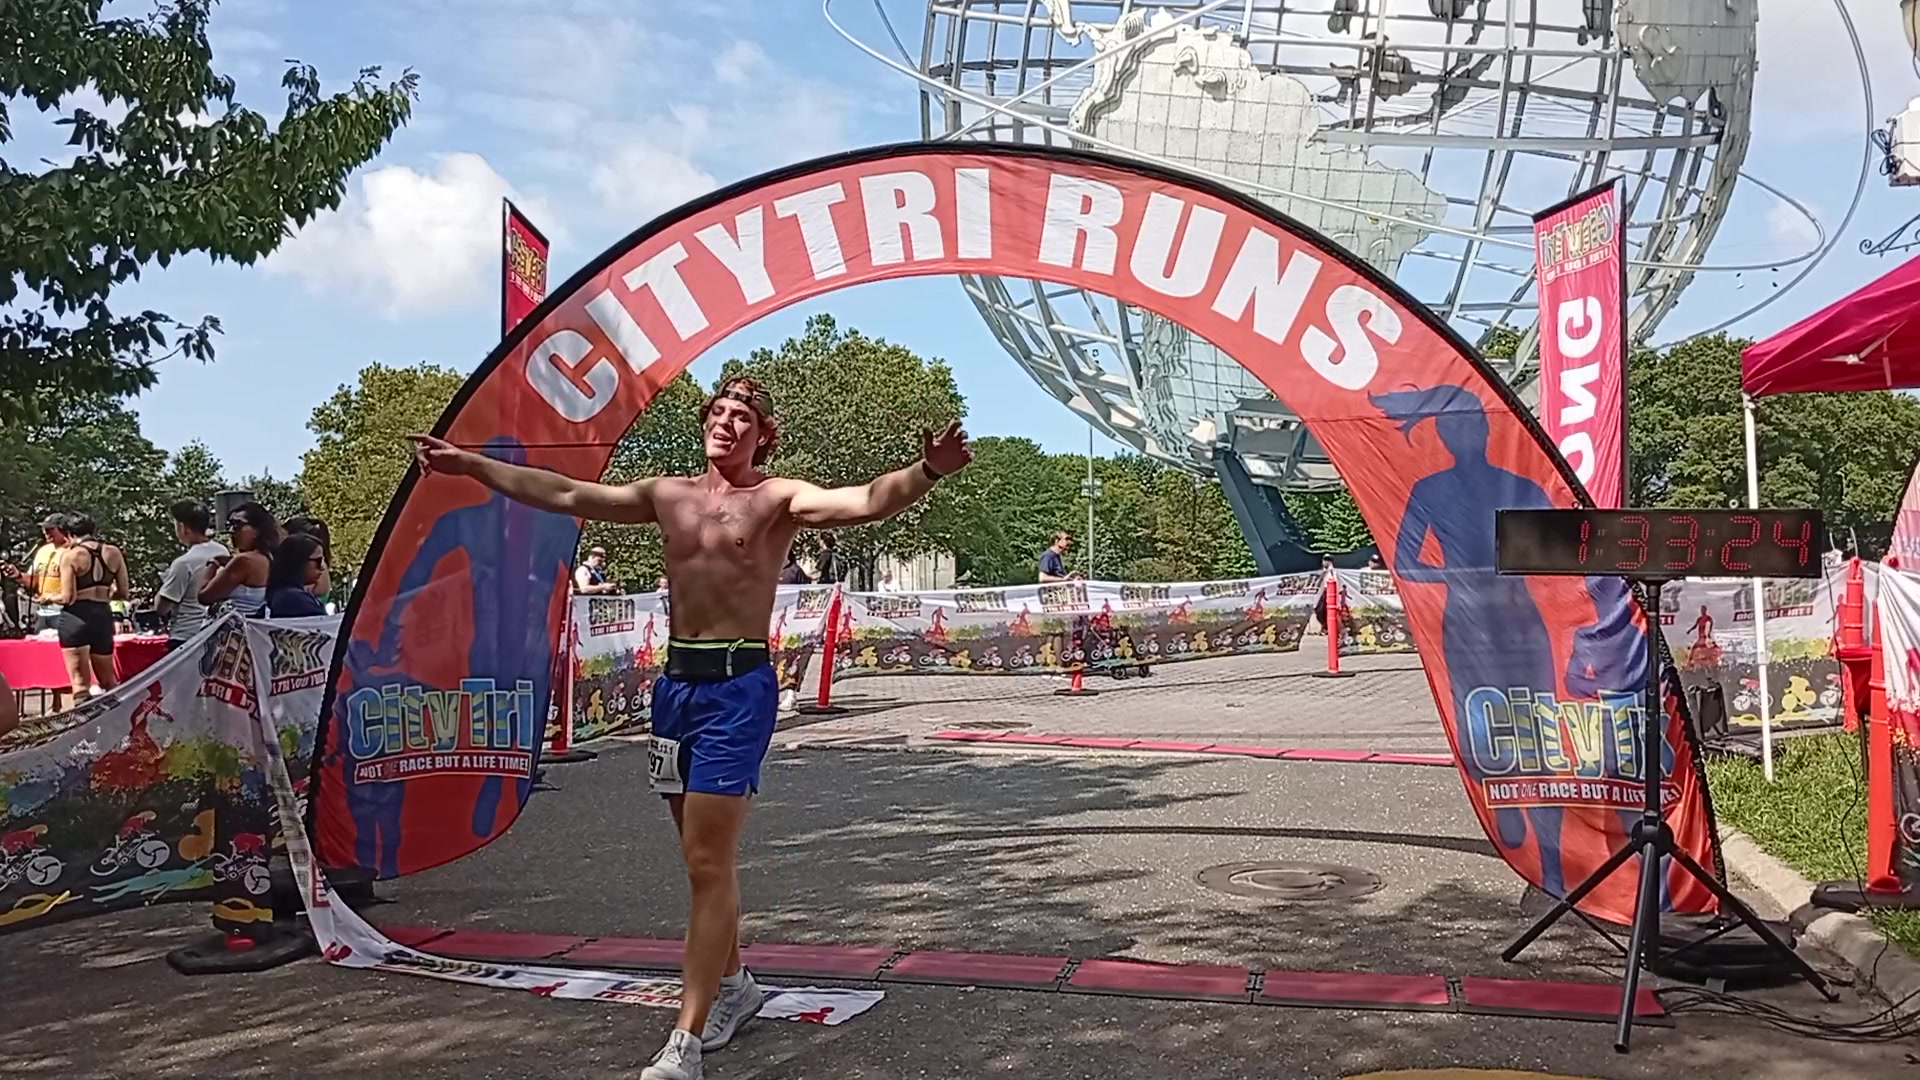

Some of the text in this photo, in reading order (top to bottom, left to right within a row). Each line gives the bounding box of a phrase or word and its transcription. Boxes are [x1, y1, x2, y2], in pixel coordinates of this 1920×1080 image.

[525, 168, 1402, 423] CITYTRI RUNS
[1577, 515, 1809, 570] 1:33:24
[347, 679, 533, 759] CityTri
[359, 763, 383, 779] NOT
[400, 756, 432, 773] RACE
[435, 754, 459, 769] BUT
[462, 755, 471, 768] A
[473, 755, 497, 768] LIFE
[499, 756, 528, 772] TIME!
[1489, 783, 1519, 800] NOT
[1520, 783, 1538, 798] ONE
[1538, 782, 1579, 799] RACE
[1580, 783, 1609, 800] BUT
[1612, 786, 1621, 802] A
